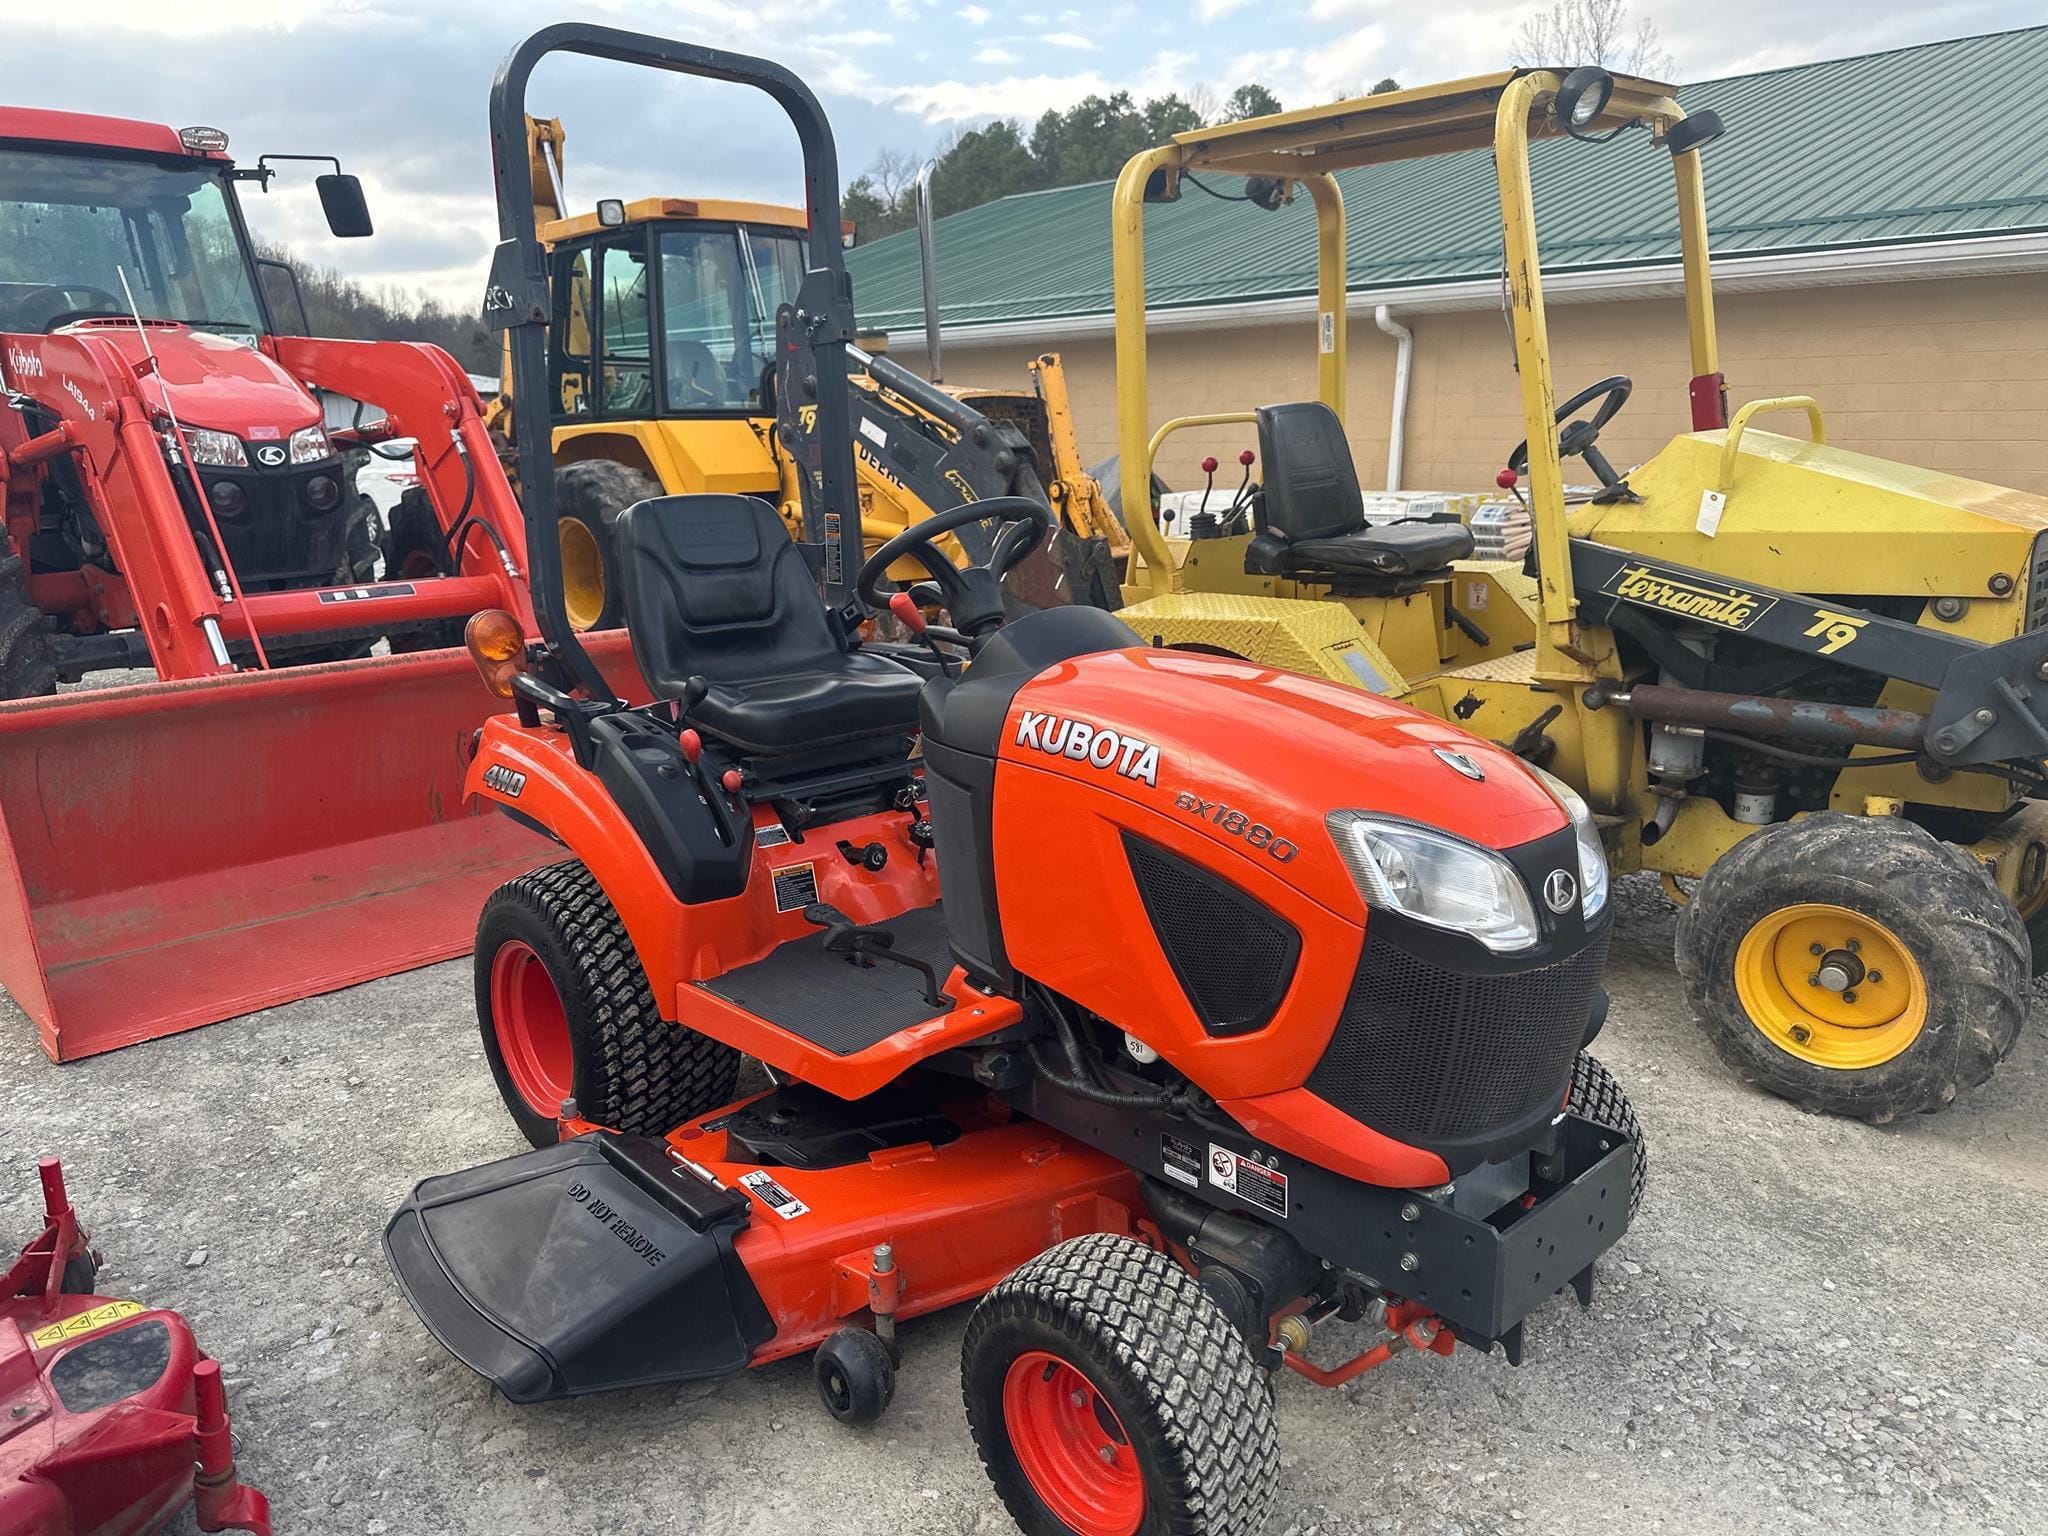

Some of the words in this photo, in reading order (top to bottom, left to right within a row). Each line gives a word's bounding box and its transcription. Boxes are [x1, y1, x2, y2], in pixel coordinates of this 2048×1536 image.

[8, 347, 43, 377] Kubota
[62, 373, 95, 421] LA1944
[798, 404, 818, 434] T9
[1616, 566, 1759, 627] terramite
[1802, 609, 1871, 655] T9
[1015, 711, 1161, 788] KUBOTA
[483, 763, 528, 798] 4WD
[1174, 791, 1300, 863] BX1880
[1246, 1162, 1272, 1178] DANGER
[568, 1183, 591, 1202] DO
[586, 1198, 618, 1223] NOT
[609, 1219, 667, 1268] REMOVE
